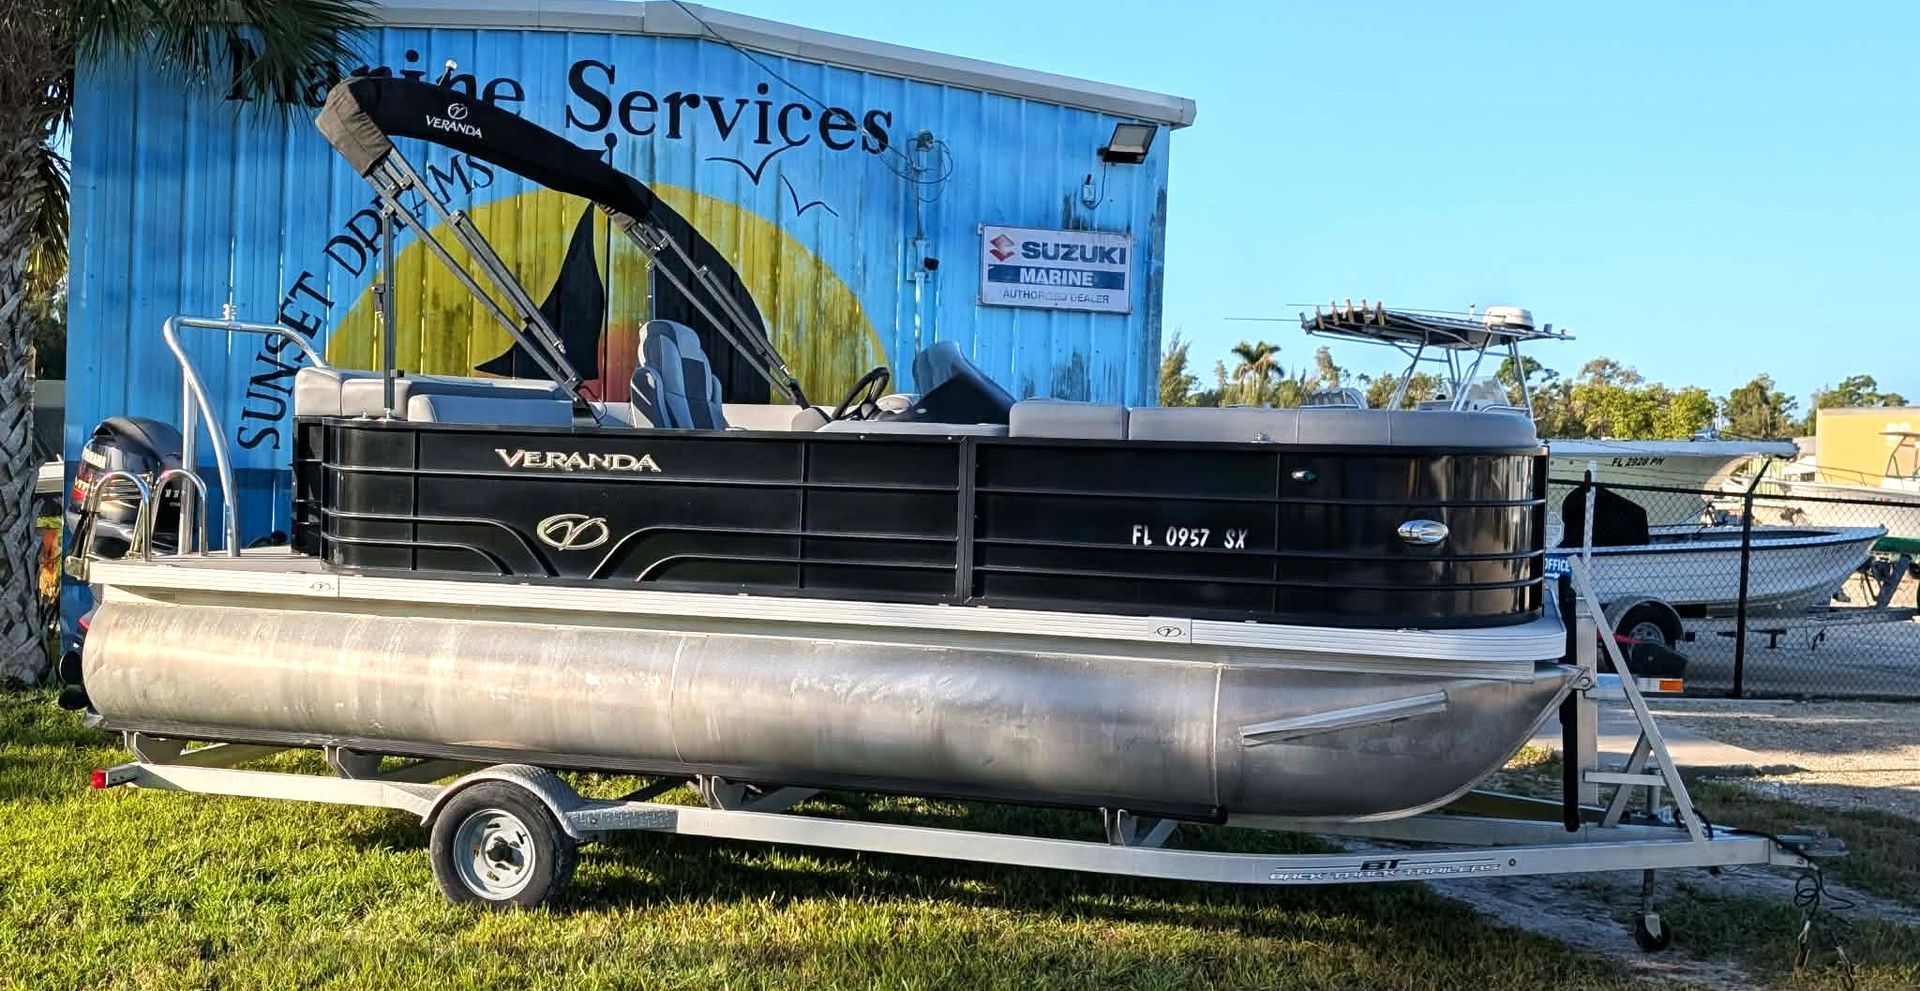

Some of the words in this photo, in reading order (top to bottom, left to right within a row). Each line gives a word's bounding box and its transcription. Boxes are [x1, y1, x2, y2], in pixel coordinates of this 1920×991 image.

[565, 59, 892, 155] Services
[426, 114, 483, 139] VERANDA
[1021, 241, 1126, 265] SUZUKI
[1020, 267, 1094, 287] MARINE
[1070, 293, 1110, 304] DEALER
[237, 271, 335, 450] SUNSET
[495, 448, 662, 473] VERANDA
[1612, 457, 1623, 467] FL
[1132, 524, 1153, 546] FL
[1166, 526, 1210, 547] 0957
[1224, 528, 1248, 549] SX
[1361, 859, 1400, 871] BT
[1405, 864, 1500, 876] TRAILERS
